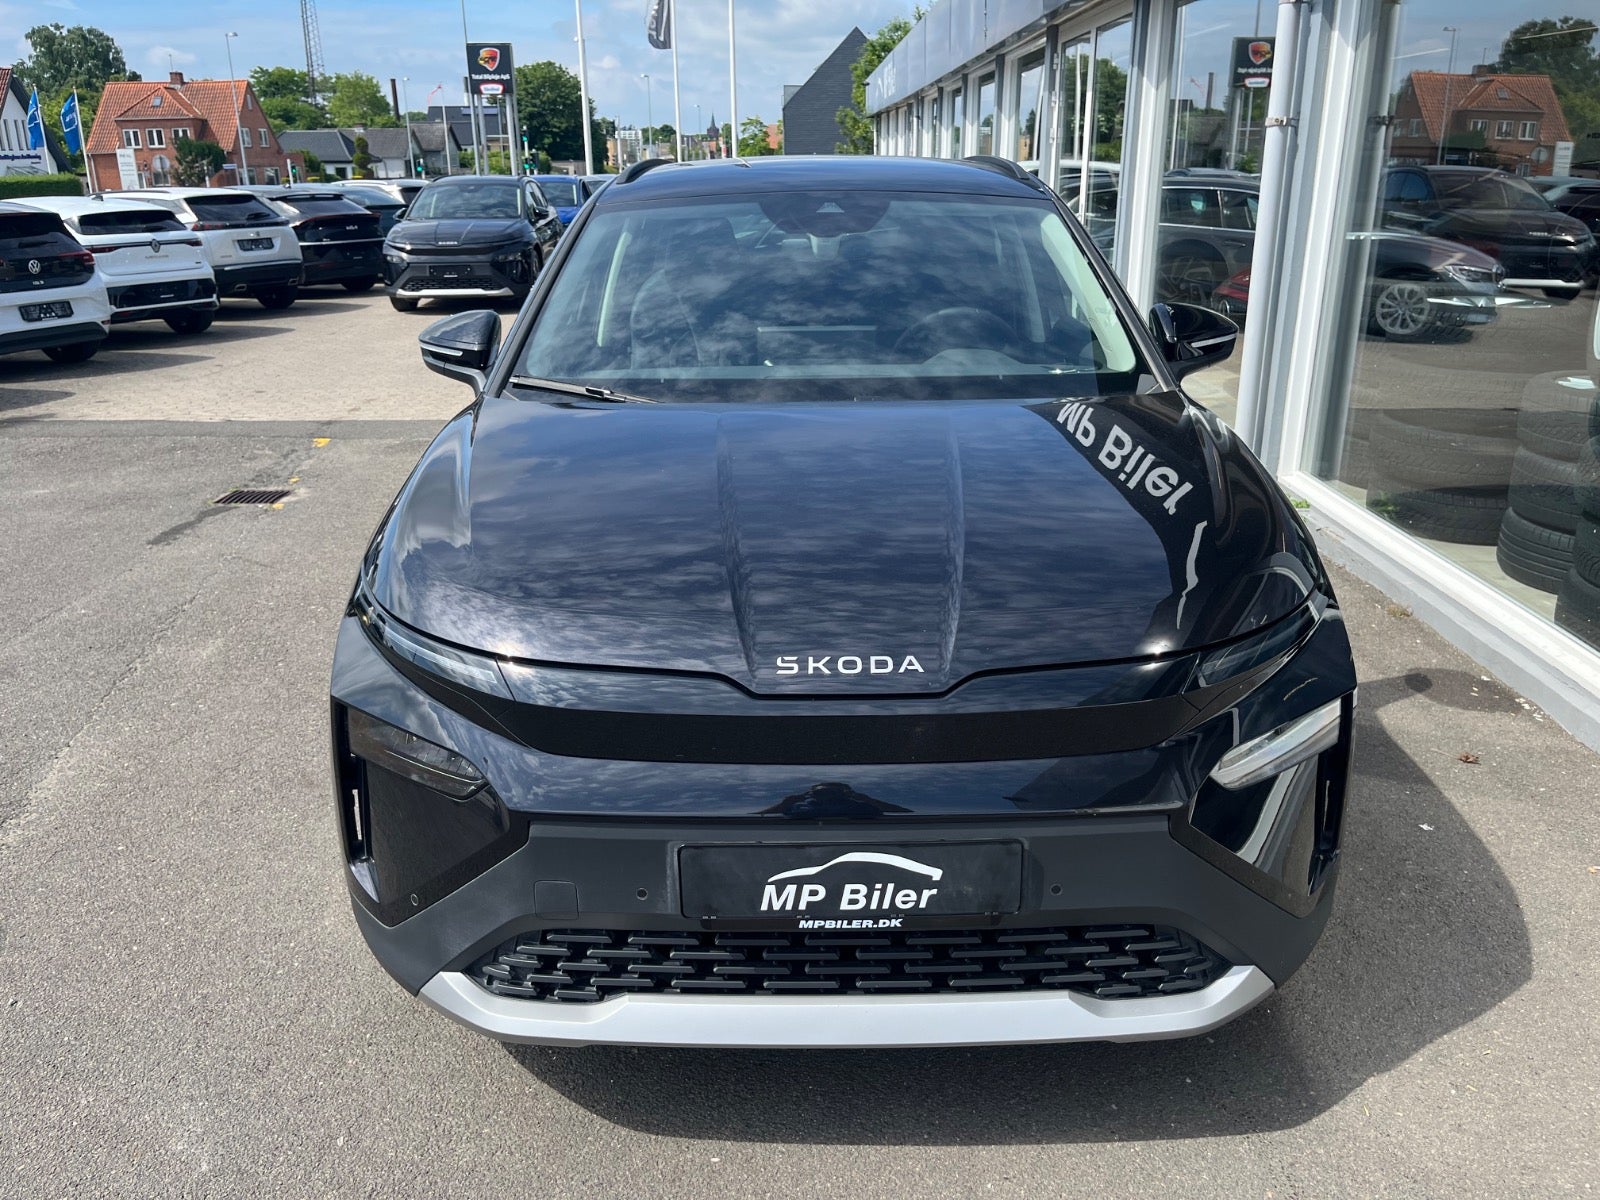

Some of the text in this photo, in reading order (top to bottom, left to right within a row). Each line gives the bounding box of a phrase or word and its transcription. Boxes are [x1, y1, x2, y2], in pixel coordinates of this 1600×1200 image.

[775, 655, 925, 675] SKODA
[760, 882, 938, 911] MP Biler
[798, 918, 903, 929] MPBILER.DK
